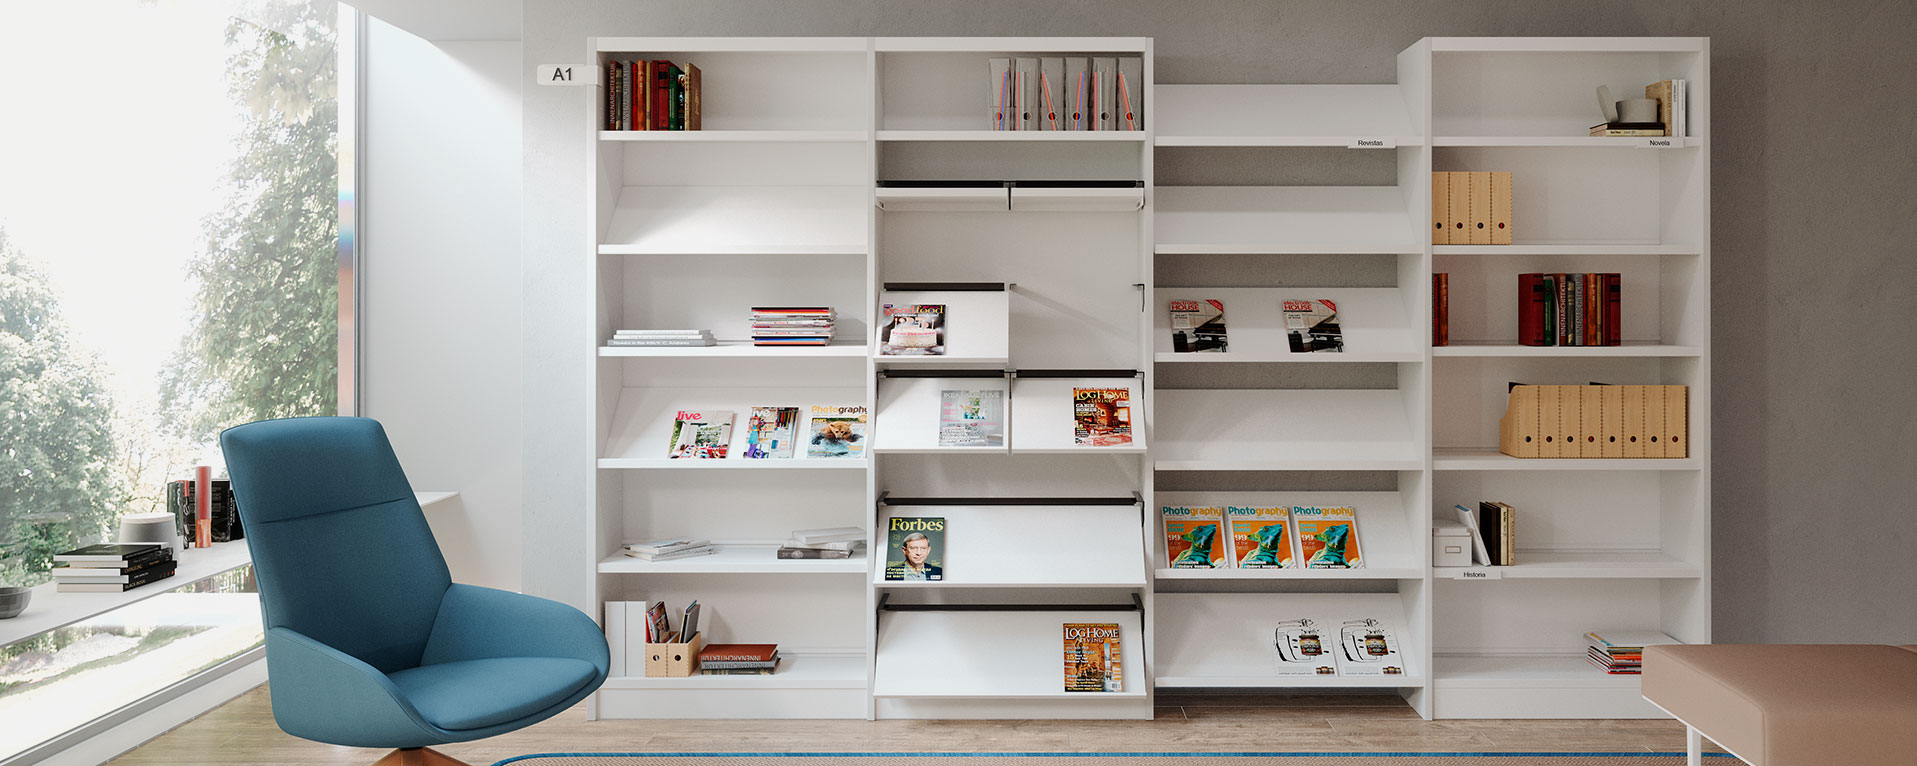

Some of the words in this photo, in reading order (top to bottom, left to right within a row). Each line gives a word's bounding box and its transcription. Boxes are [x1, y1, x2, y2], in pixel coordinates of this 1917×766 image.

[552, 68, 572, 81] A1
[884, 305, 915, 316] good
[916, 305, 943, 313] food
[1076, 390, 1097, 400] LOG
[1097, 390, 1128, 400] HOME
[677, 411, 702, 420] live
[1163, 506, 1222, 516] Photography
[1228, 506, 1288, 516] Photography
[1293, 506, 1353, 516] Photography
[891, 518, 944, 531] Forbes
[1065, 628, 1086, 640] LOG
[1087, 628, 1119, 638] HOME
